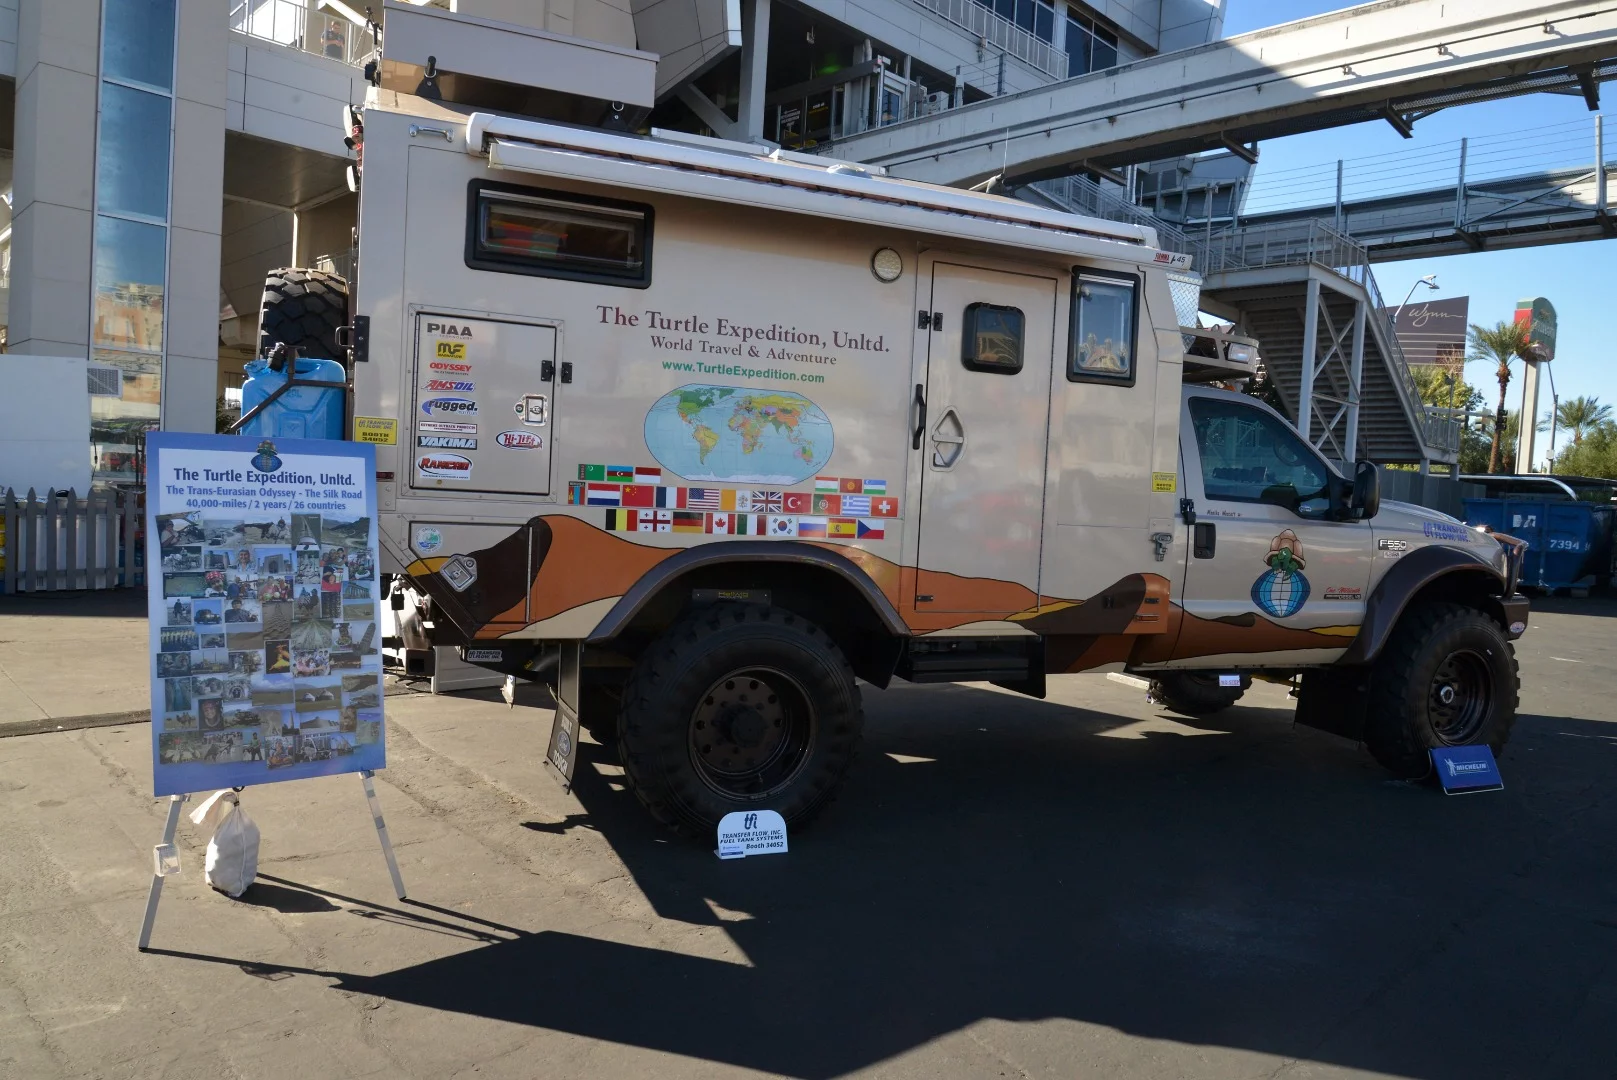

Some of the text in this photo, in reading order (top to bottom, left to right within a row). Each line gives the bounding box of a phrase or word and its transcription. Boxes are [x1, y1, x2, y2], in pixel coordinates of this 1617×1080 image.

[427, 323, 473, 337] PIAA
[596, 305, 889, 353] The Turtle Expedition, Unltd.
[650, 335, 837, 365] World Travel & Adventure
[429, 362, 472, 372] ODYSSEY
[661, 360, 825, 383] www.TurtleExpedition.com
[424, 380, 476, 391] AMSOIL
[420, 436, 475, 448] YAKIMA
[173, 468, 355, 486] The Turtle Expedition, Unltd.
[165, 485, 184, 495] The
[186, 485, 256, 497] Trans-Eurasian
[259, 487, 296, 499] Odyssey
[304, 488, 321, 498] The
[323, 489, 339, 499] Silk
[341, 490, 362, 499] Road
[186, 499, 247, 509] 40,000-miles
[255, 500, 260, 508] 2
[262, 501, 287, 511] years
[294, 501, 305, 510] 26
[307, 501, 346, 511] countries
[1432, 523, 1468, 535] TRANSFER
[1550, 539, 1580, 550] 7394
[1456, 763, 1487, 771] MICHELIN
[722, 832, 751, 840] TRANSFER
